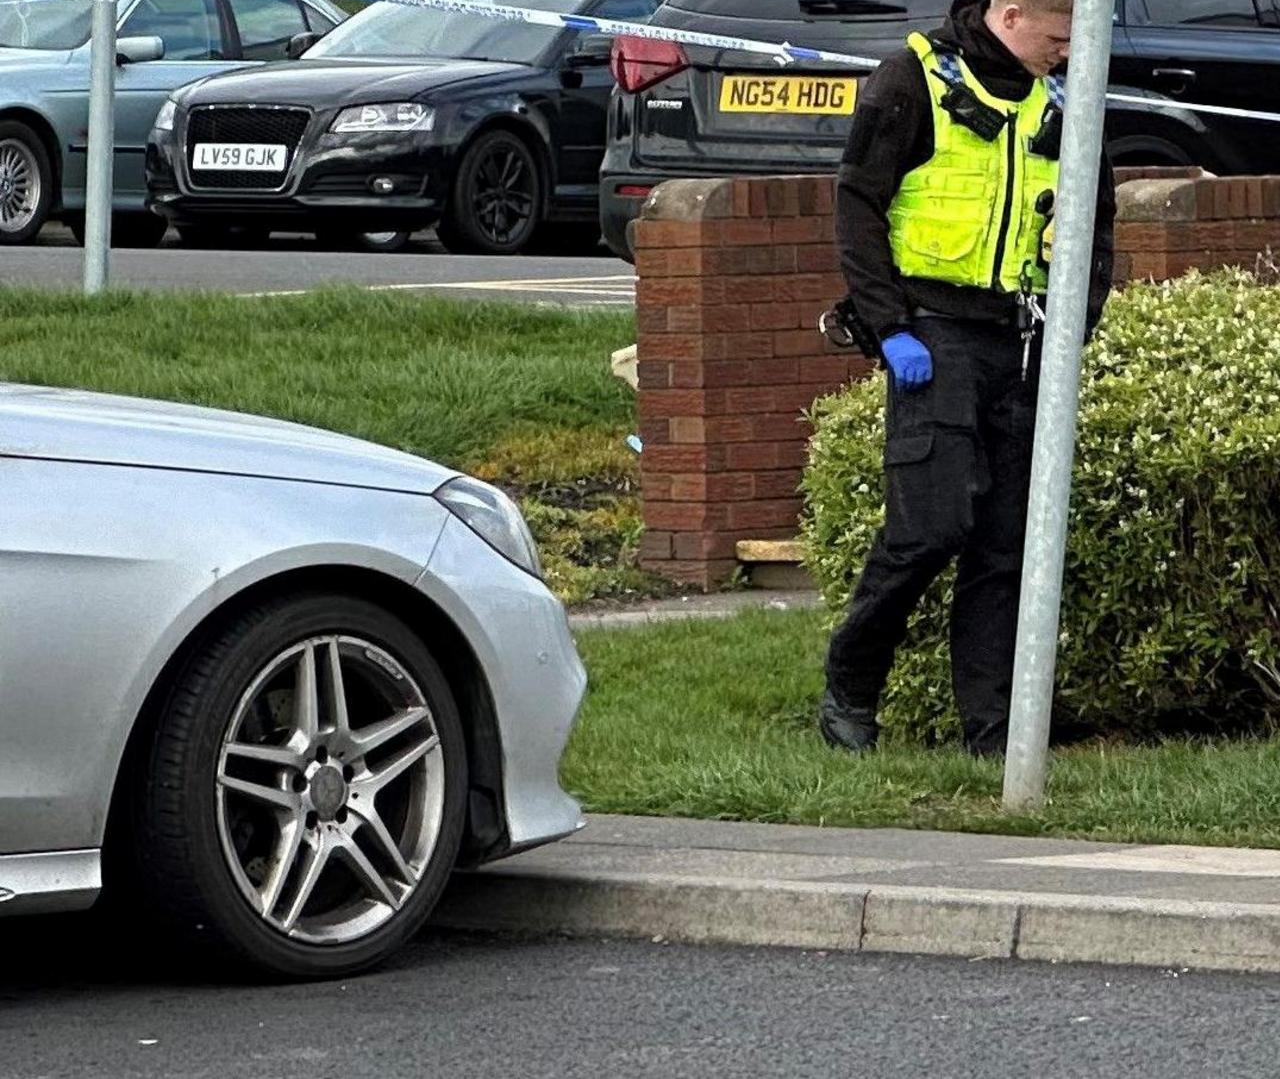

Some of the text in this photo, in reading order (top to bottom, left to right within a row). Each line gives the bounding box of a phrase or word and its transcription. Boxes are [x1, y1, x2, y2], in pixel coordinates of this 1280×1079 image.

[730, 79, 845, 108] NG54 HDG
[201, 148, 277, 166] LV59 GJK
